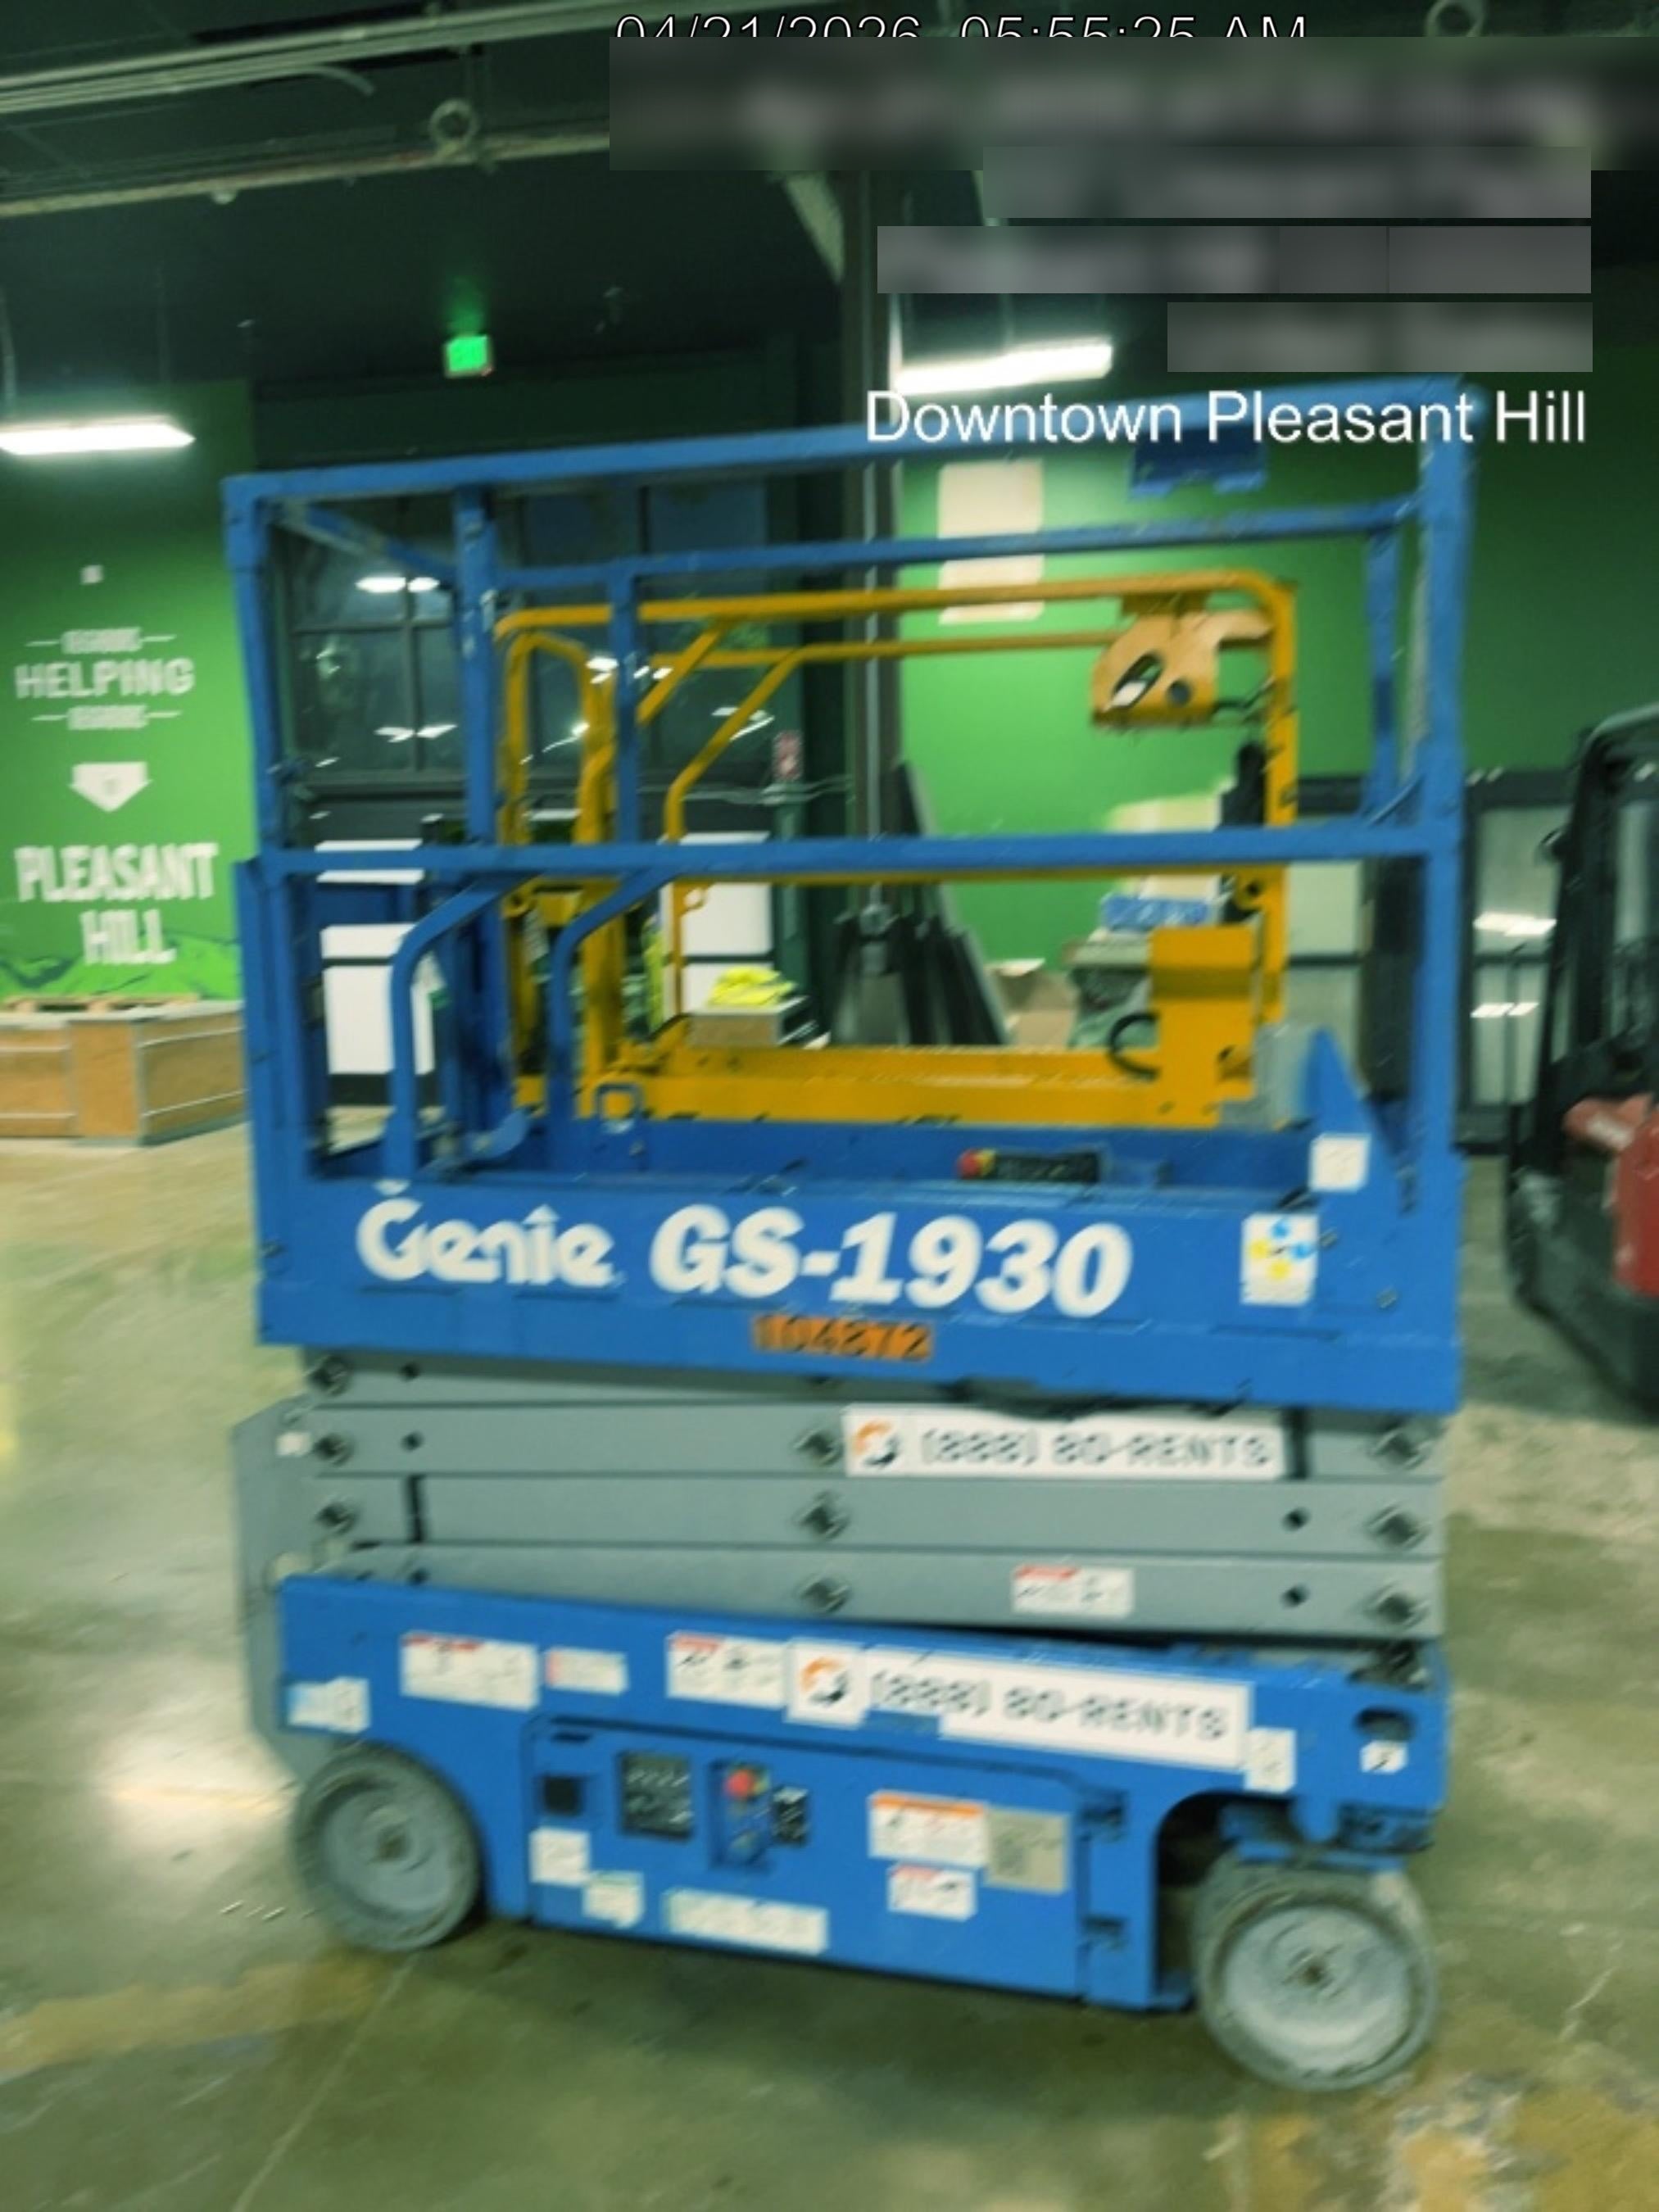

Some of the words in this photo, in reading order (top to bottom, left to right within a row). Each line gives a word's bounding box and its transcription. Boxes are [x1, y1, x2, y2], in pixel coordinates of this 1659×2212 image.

[14, 658, 196, 698] HELPING
[14, 841, 219, 902] PLEASANT
[79, 909, 176, 964] HILL
[356, 1180, 615, 1287] Genie
[650, 1203, 1133, 1318] GS-1930
[921, 1427, 1038, 1466] (888)
[870, 1668, 991, 1717] (888)
